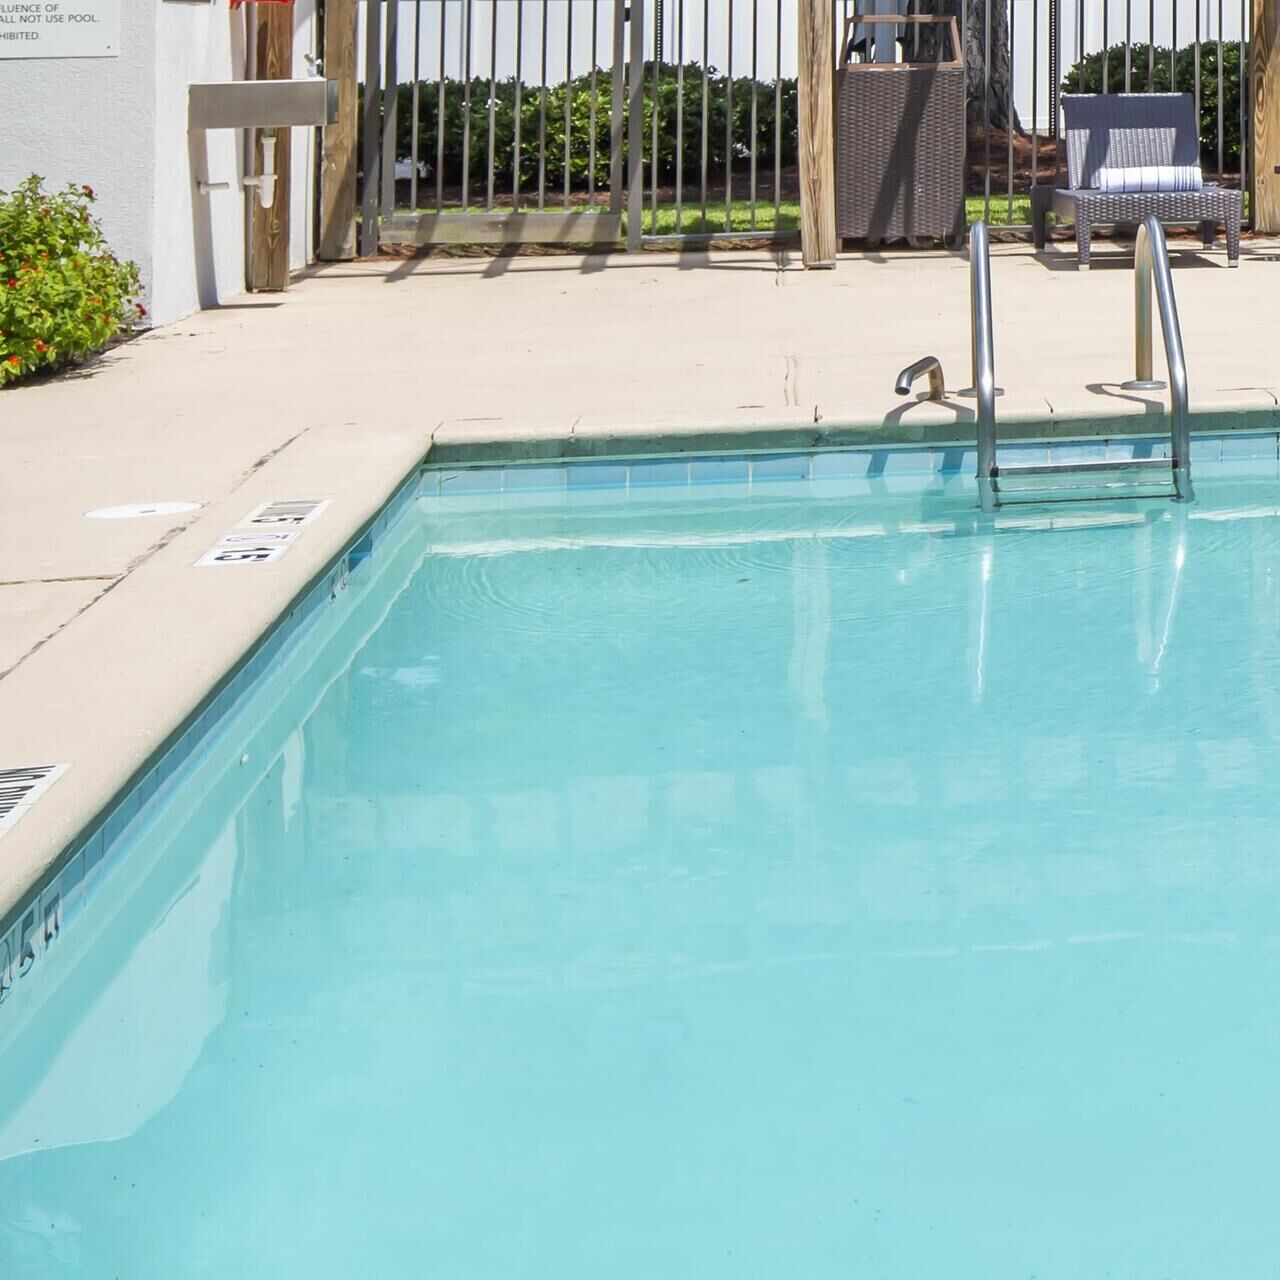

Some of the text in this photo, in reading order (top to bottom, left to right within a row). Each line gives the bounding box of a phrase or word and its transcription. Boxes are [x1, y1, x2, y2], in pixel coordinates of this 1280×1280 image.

[0, 3, 60, 13] LUENCE OF
[19, 14, 42, 24] NOT
[45, 14, 65, 23] USE
